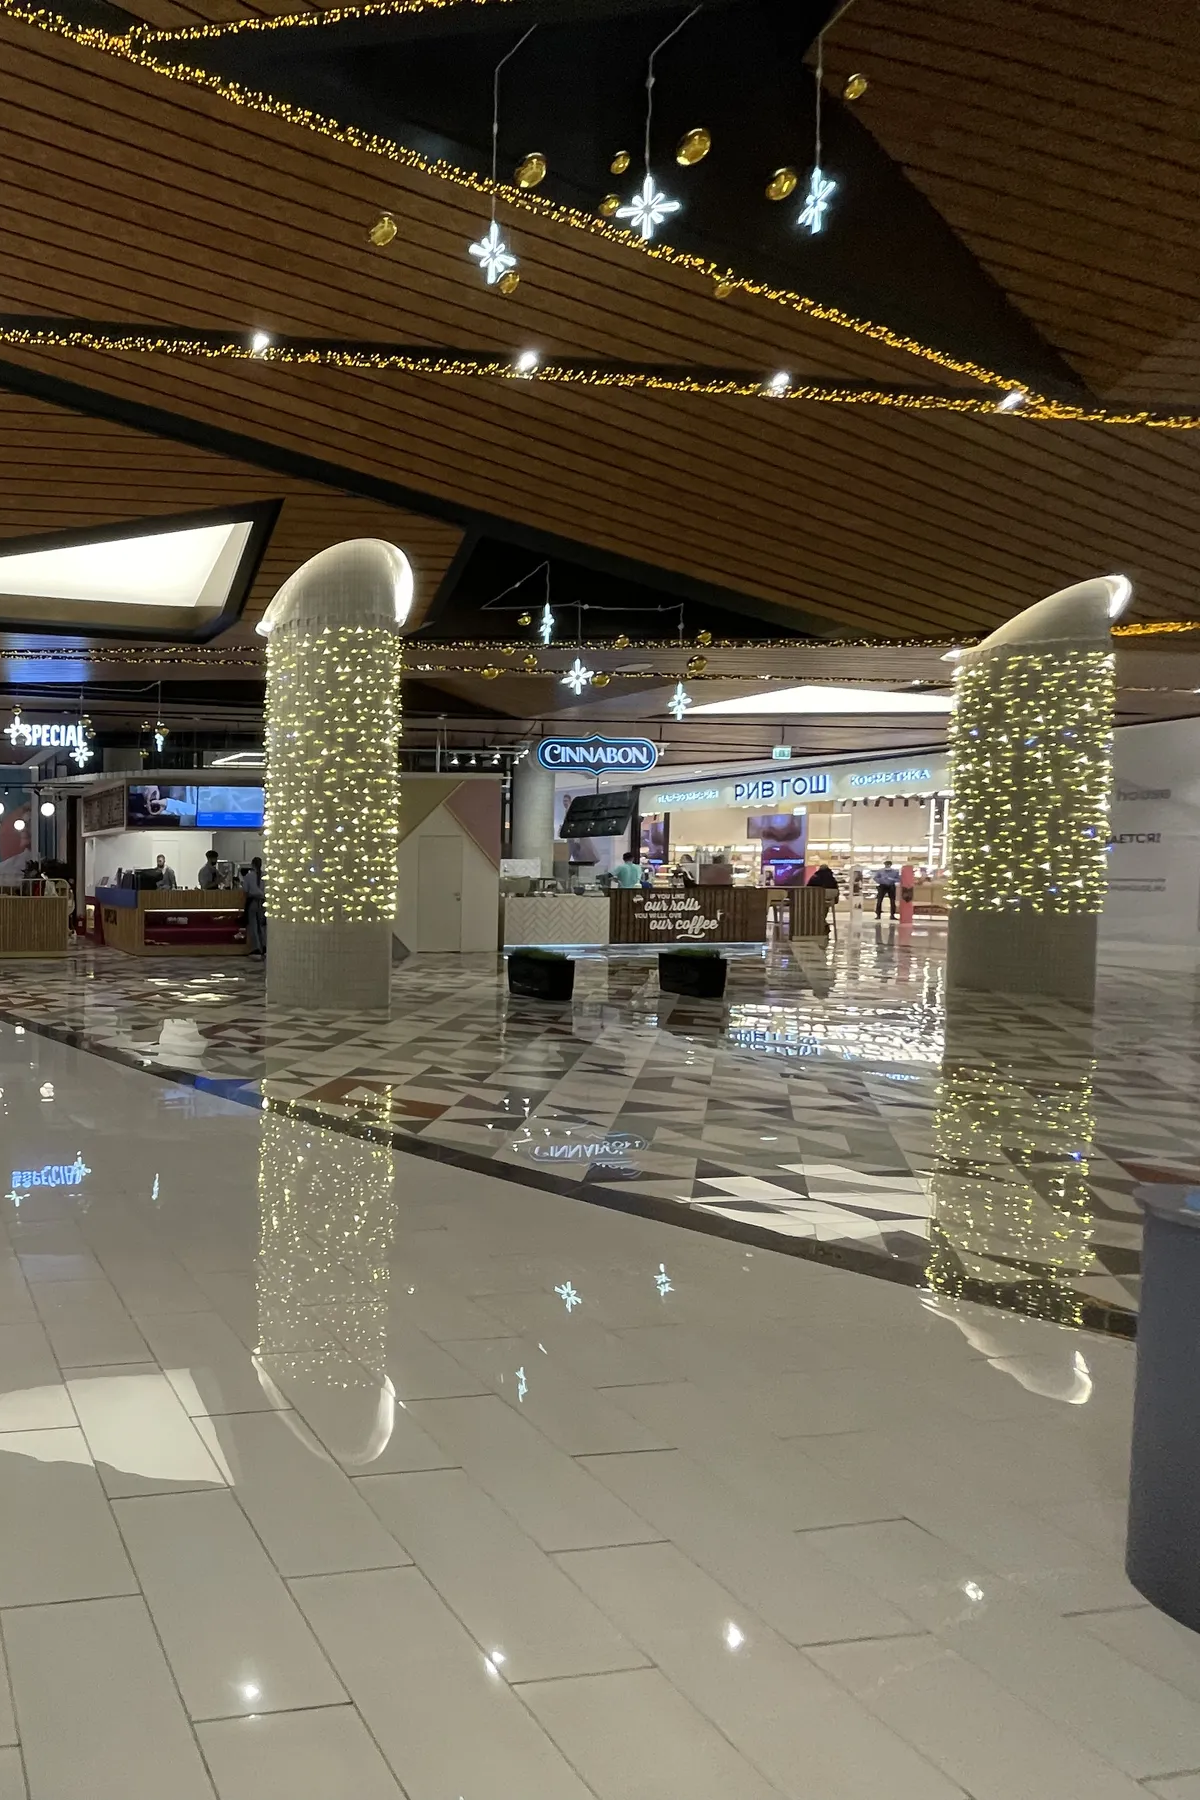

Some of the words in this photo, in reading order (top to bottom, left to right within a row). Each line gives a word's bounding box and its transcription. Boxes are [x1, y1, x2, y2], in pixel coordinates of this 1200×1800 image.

[544, 743, 649, 764] CINNABON
[734, 780, 776, 801] РИВ
[781, 774, 830, 797] ГОШ
[851, 769, 931, 786] КОСМЕТИКА
[644, 900, 669, 912] our
[669, 898, 701, 911] rolls
[649, 919, 675, 930] our
[675, 915, 719, 935] coffee
